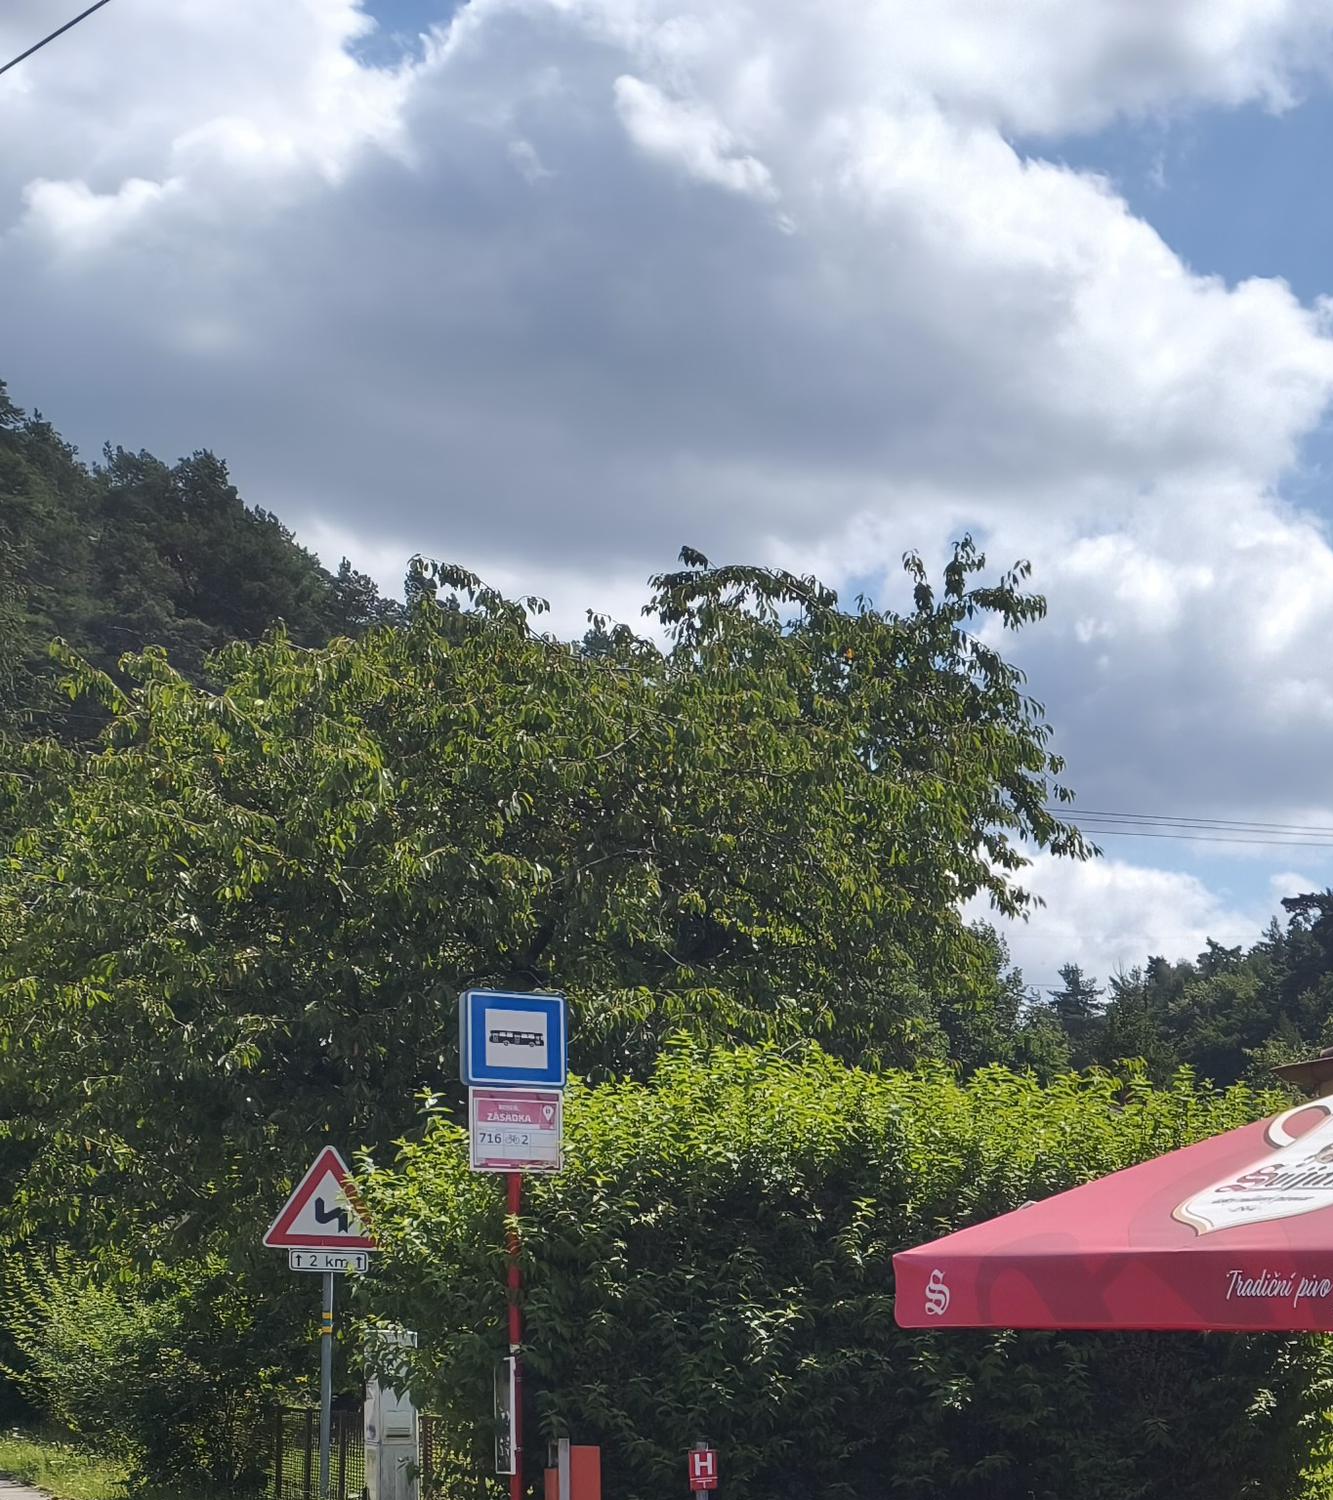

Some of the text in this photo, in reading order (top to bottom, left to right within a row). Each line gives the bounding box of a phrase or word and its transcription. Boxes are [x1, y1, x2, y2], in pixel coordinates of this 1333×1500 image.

[487, 1112, 532, 1123] ZÁSADKA
[479, 1133, 529, 1145] 716 2
[309, 1254, 349, 1267] 2 km
[1226, 1269, 1296, 1300] Tradiční
[1293, 1274, 1333, 1308] pivo
[694, 1452, 713, 1476] H
